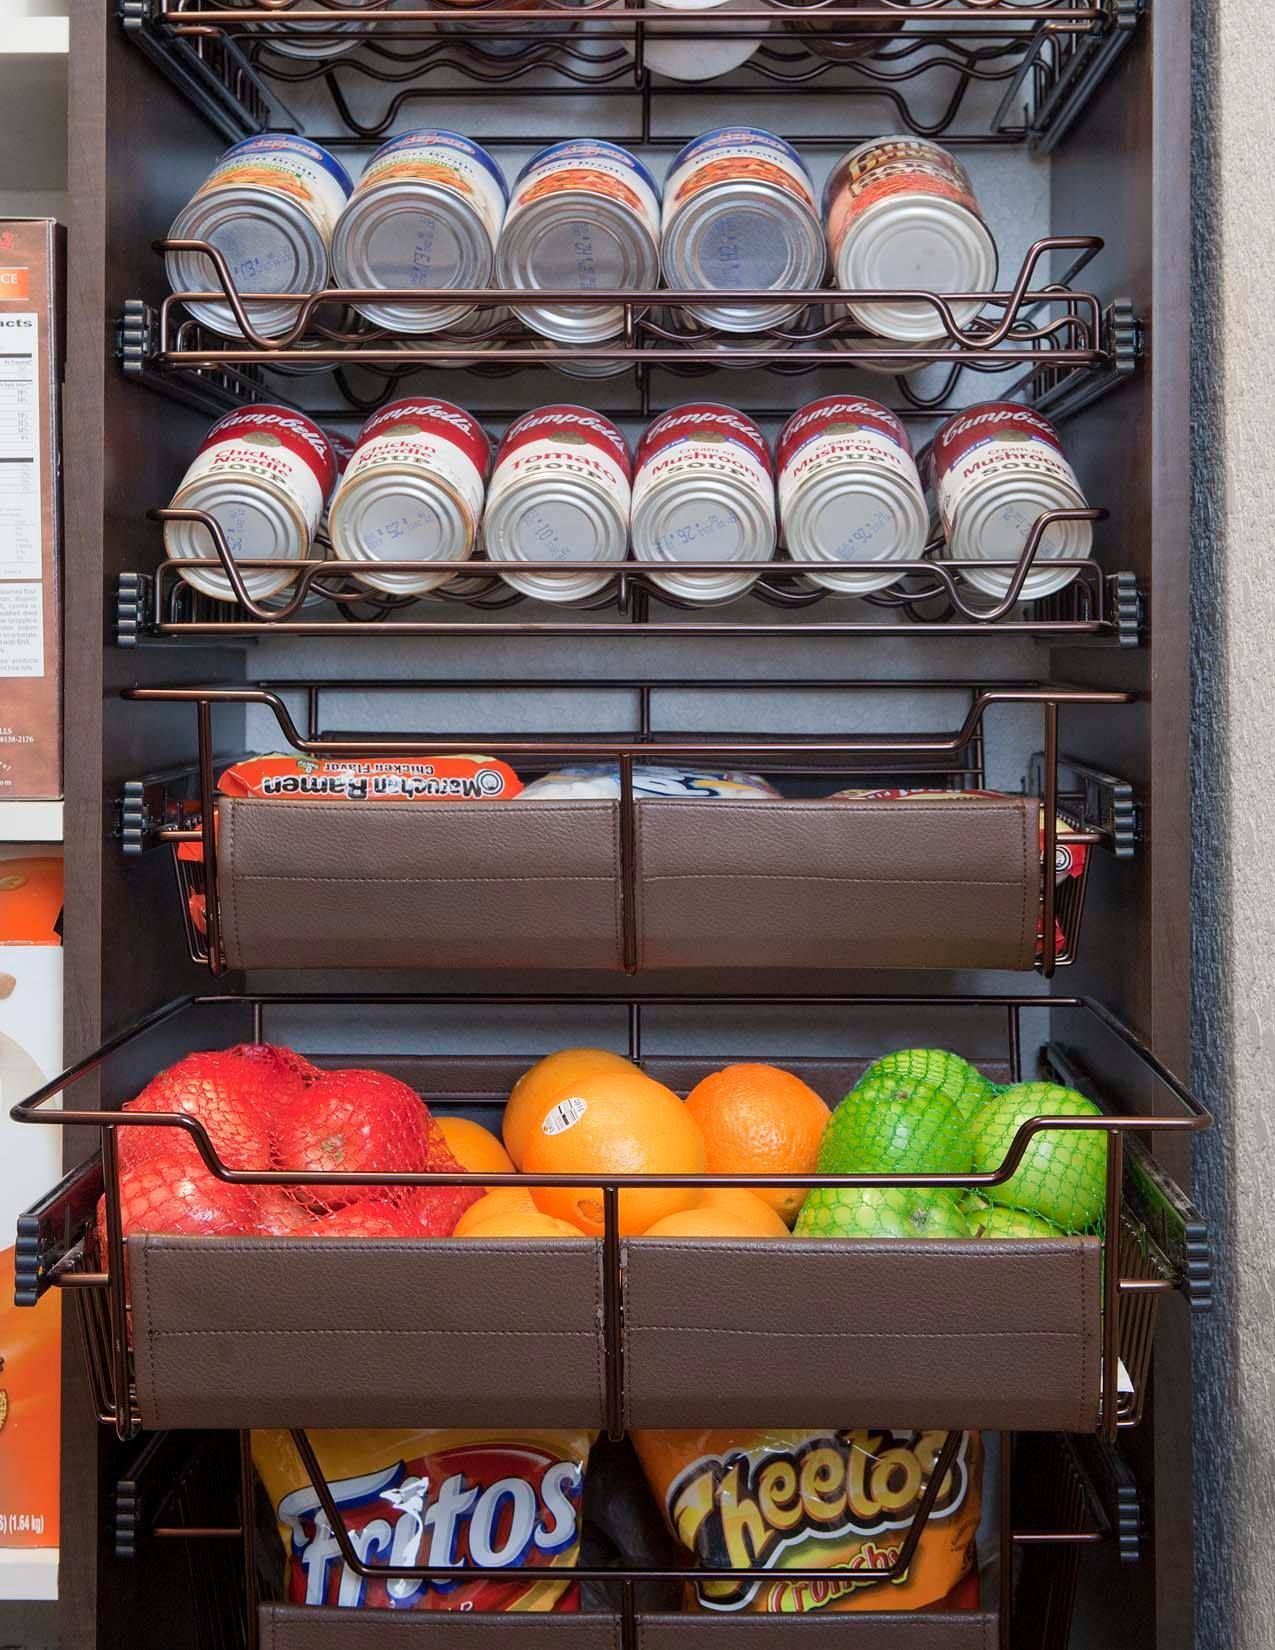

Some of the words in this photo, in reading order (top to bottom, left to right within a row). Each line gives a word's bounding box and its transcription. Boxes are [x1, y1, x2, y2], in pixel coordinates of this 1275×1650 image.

[362, 441, 437, 457] Chicken
[679, 446, 720, 455] Cream
[815, 438, 854, 450] Cream
[987, 446, 1027, 456] Cream
[213, 456, 289, 477] Noodle
[216, 449, 293, 473] Chicken
[359, 448, 433, 466] Noodle
[511, 451, 617, 484] Tomato
[651, 451, 760, 482] Mushroom
[793, 444, 901, 477] Mushroom
[962, 452, 1073, 479] Mushroom
[208, 464, 288, 484] SOUP
[525, 462, 603, 481] SOUP
[667, 461, 746, 477] SOUP
[981, 462, 1063, 477] SOUP
[324, 762, 370, 774] Flavor
[374, 763, 434, 775] Chicken
[263, 775, 368, 800] Ramen
[373, 774, 482, 799] Maruchan
[9, 1513, 30, 1535] (1.64
[31, 1513, 44, 1535] kg)
[672, 1428, 953, 1600] Cheetos
[278, 1460, 584, 1606] Fritos
[767, 1542, 910, 1612] Crunchy
